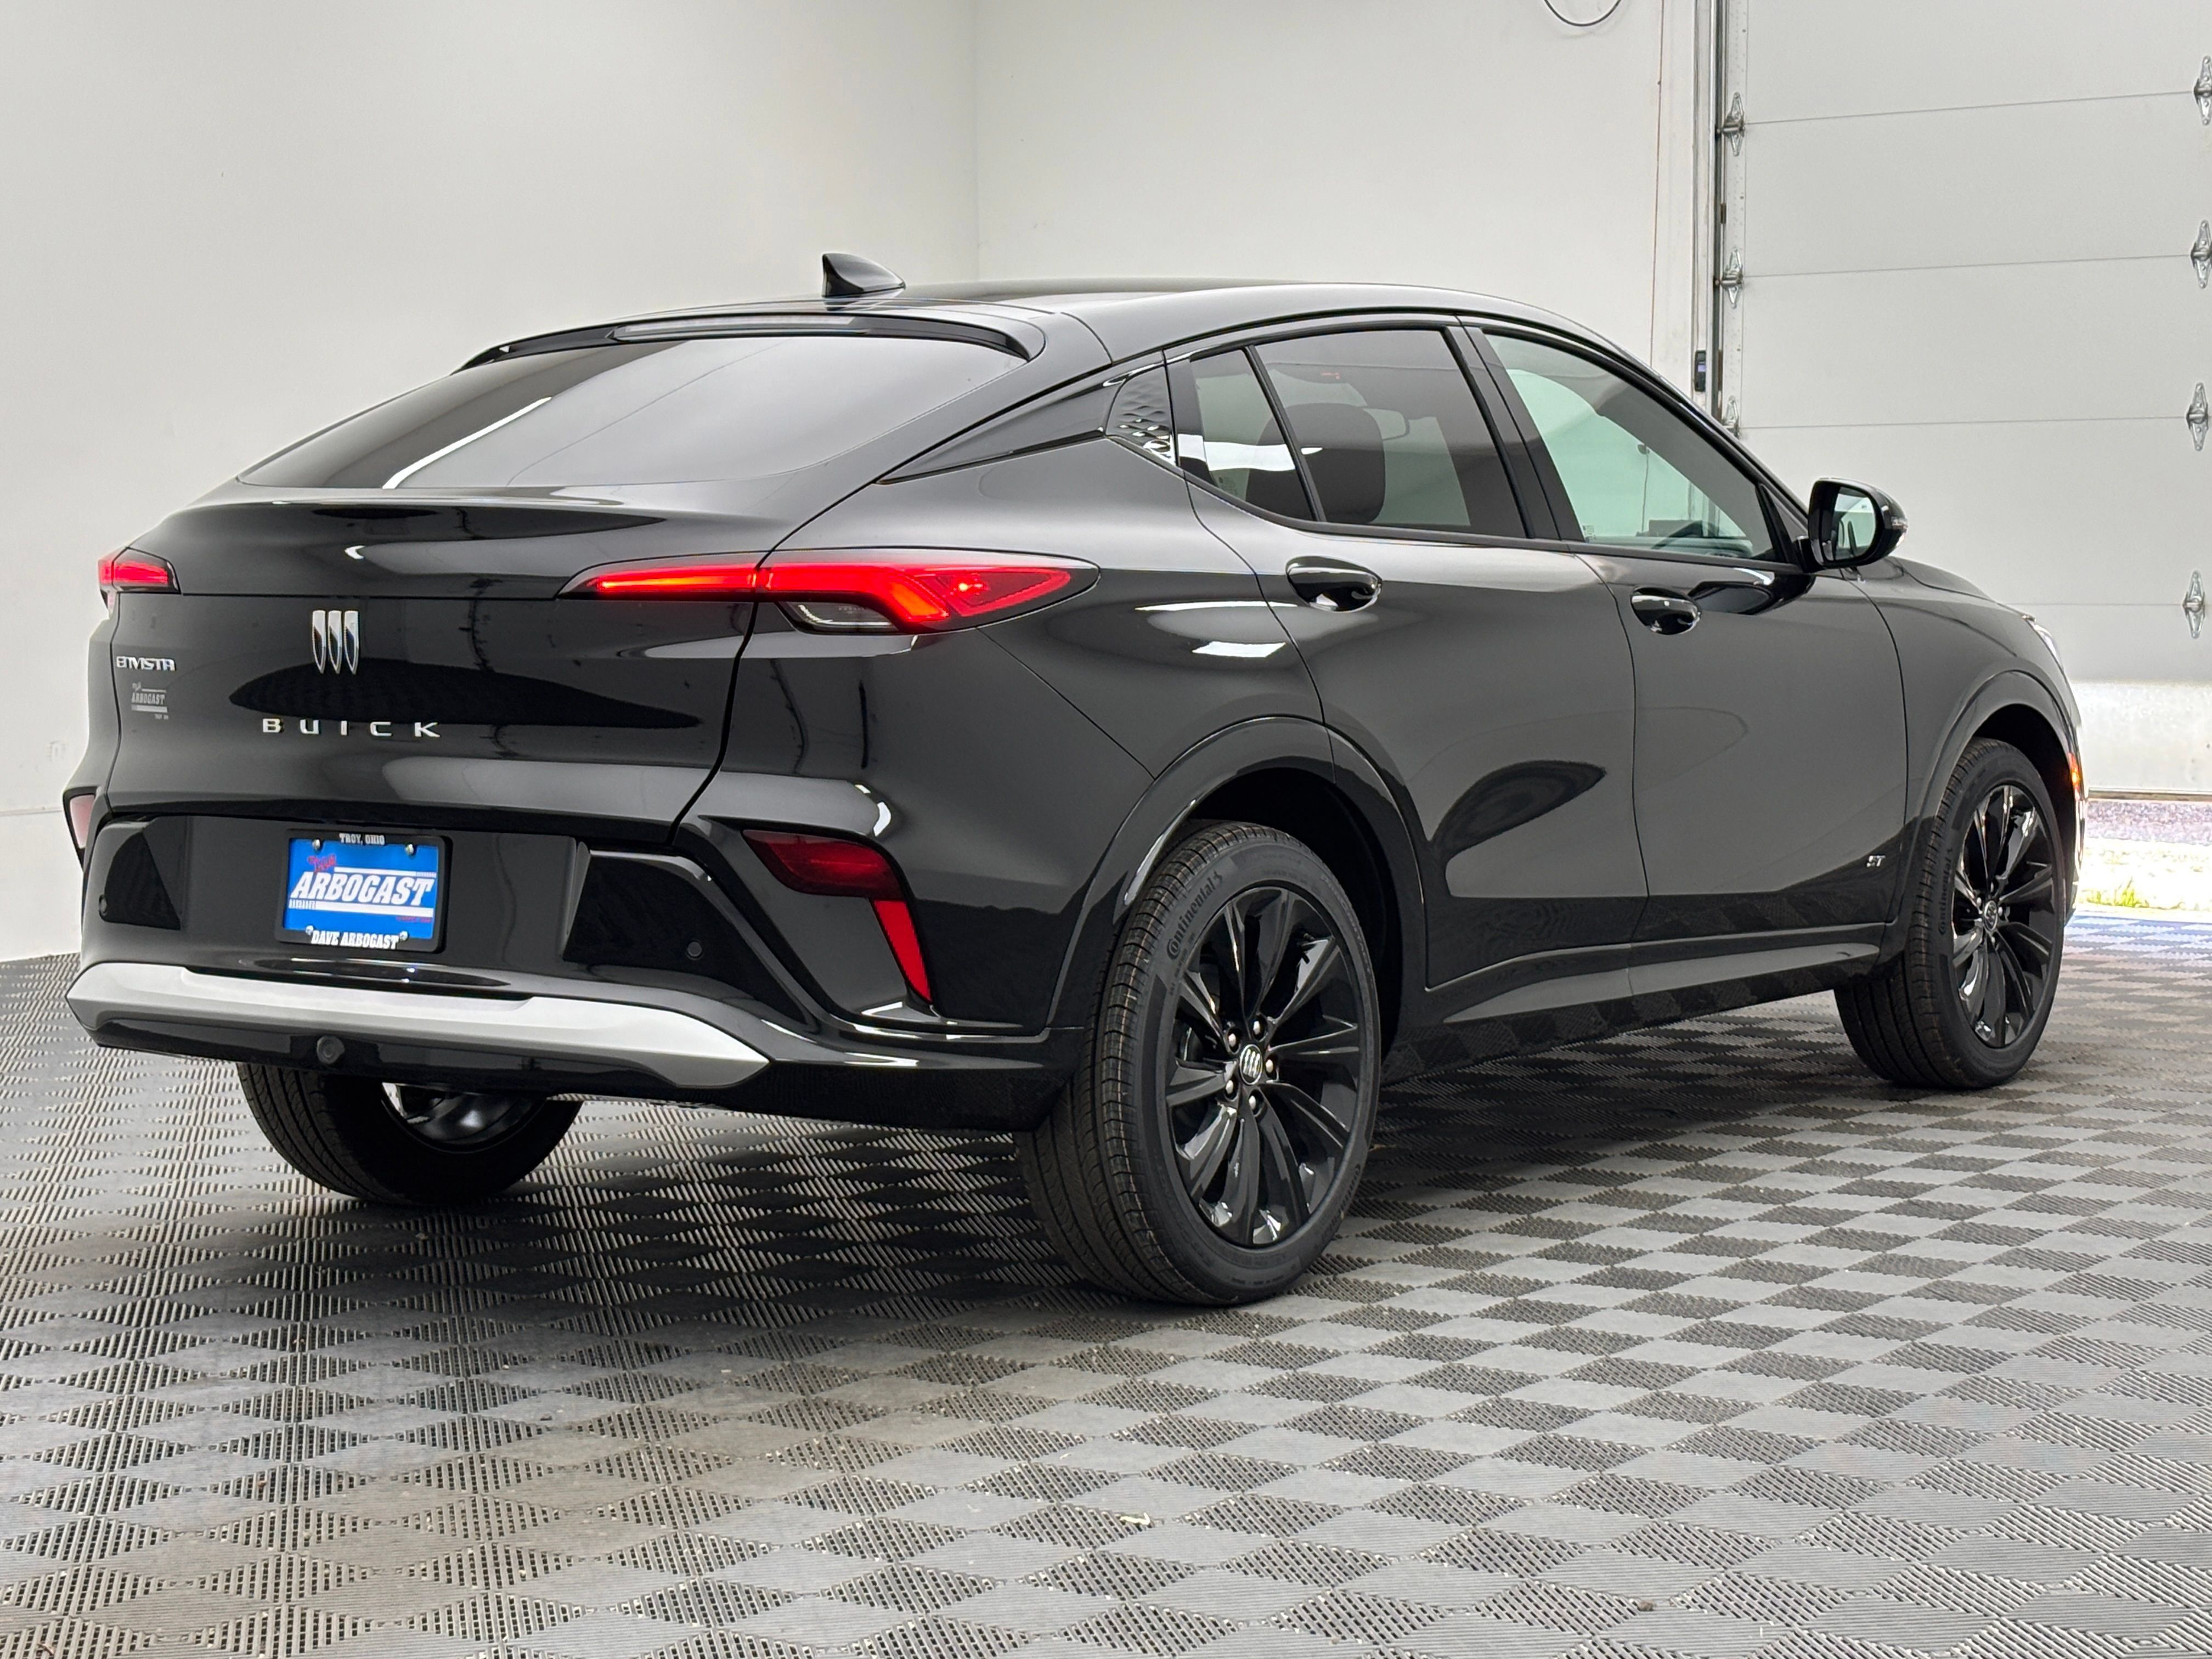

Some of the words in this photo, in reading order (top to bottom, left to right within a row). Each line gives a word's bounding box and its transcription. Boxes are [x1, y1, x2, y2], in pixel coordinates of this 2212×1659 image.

[262, 718, 440, 738] BUICK
[339, 833, 363, 845] TROY,
[365, 834, 385, 845] OHIO
[1866, 855, 1887, 868] ST
[290, 871, 435, 906] ARBOGAST
[1167, 877, 1216, 960] Continental
[311, 930, 340, 945] DAVE
[340, 932, 399, 950] ARBOGAST
